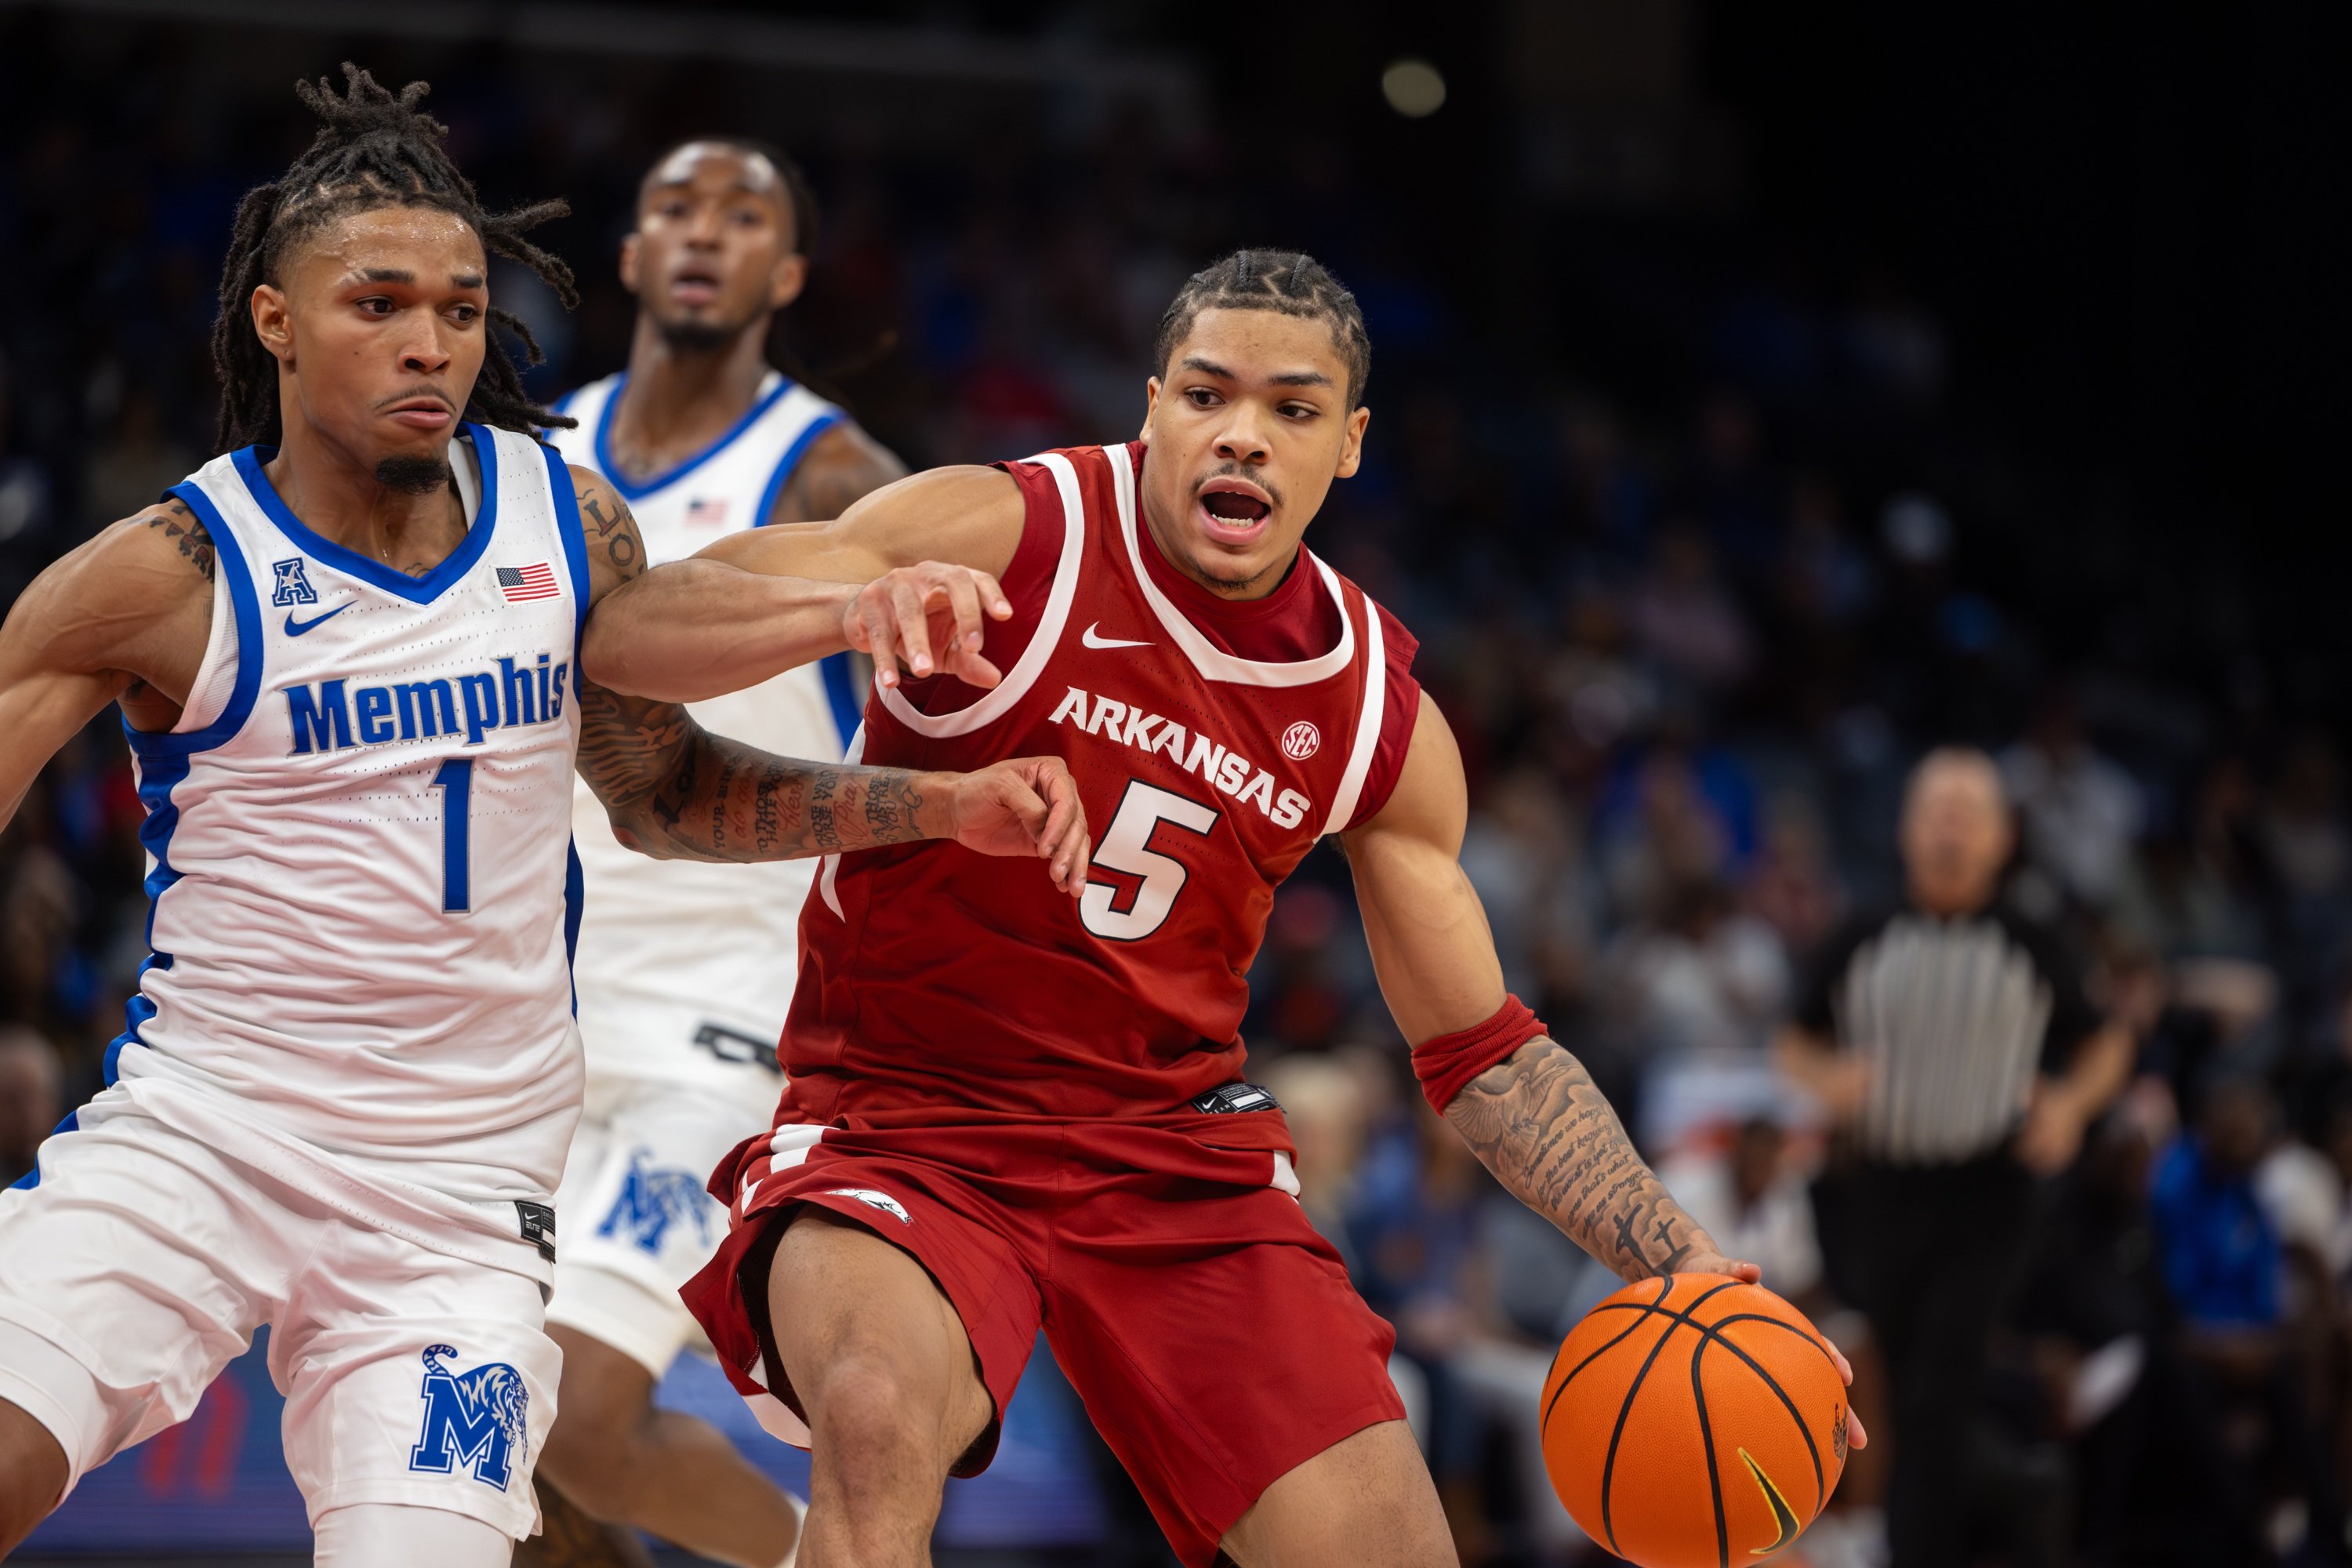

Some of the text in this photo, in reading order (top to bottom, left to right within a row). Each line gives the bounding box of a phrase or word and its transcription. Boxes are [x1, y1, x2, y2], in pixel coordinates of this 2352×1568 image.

[278, 652, 568, 757] Memphis
[1048, 685, 1311, 829] ARKANSAS
[1286, 724, 1316, 757] SEC
[428, 757, 475, 914] 1
[713, 802, 725, 848] YOUR
[1079, 777, 1222, 942] 5
[1545, 1165, 1559, 1184] the
[408, 1372, 512, 1494] M
